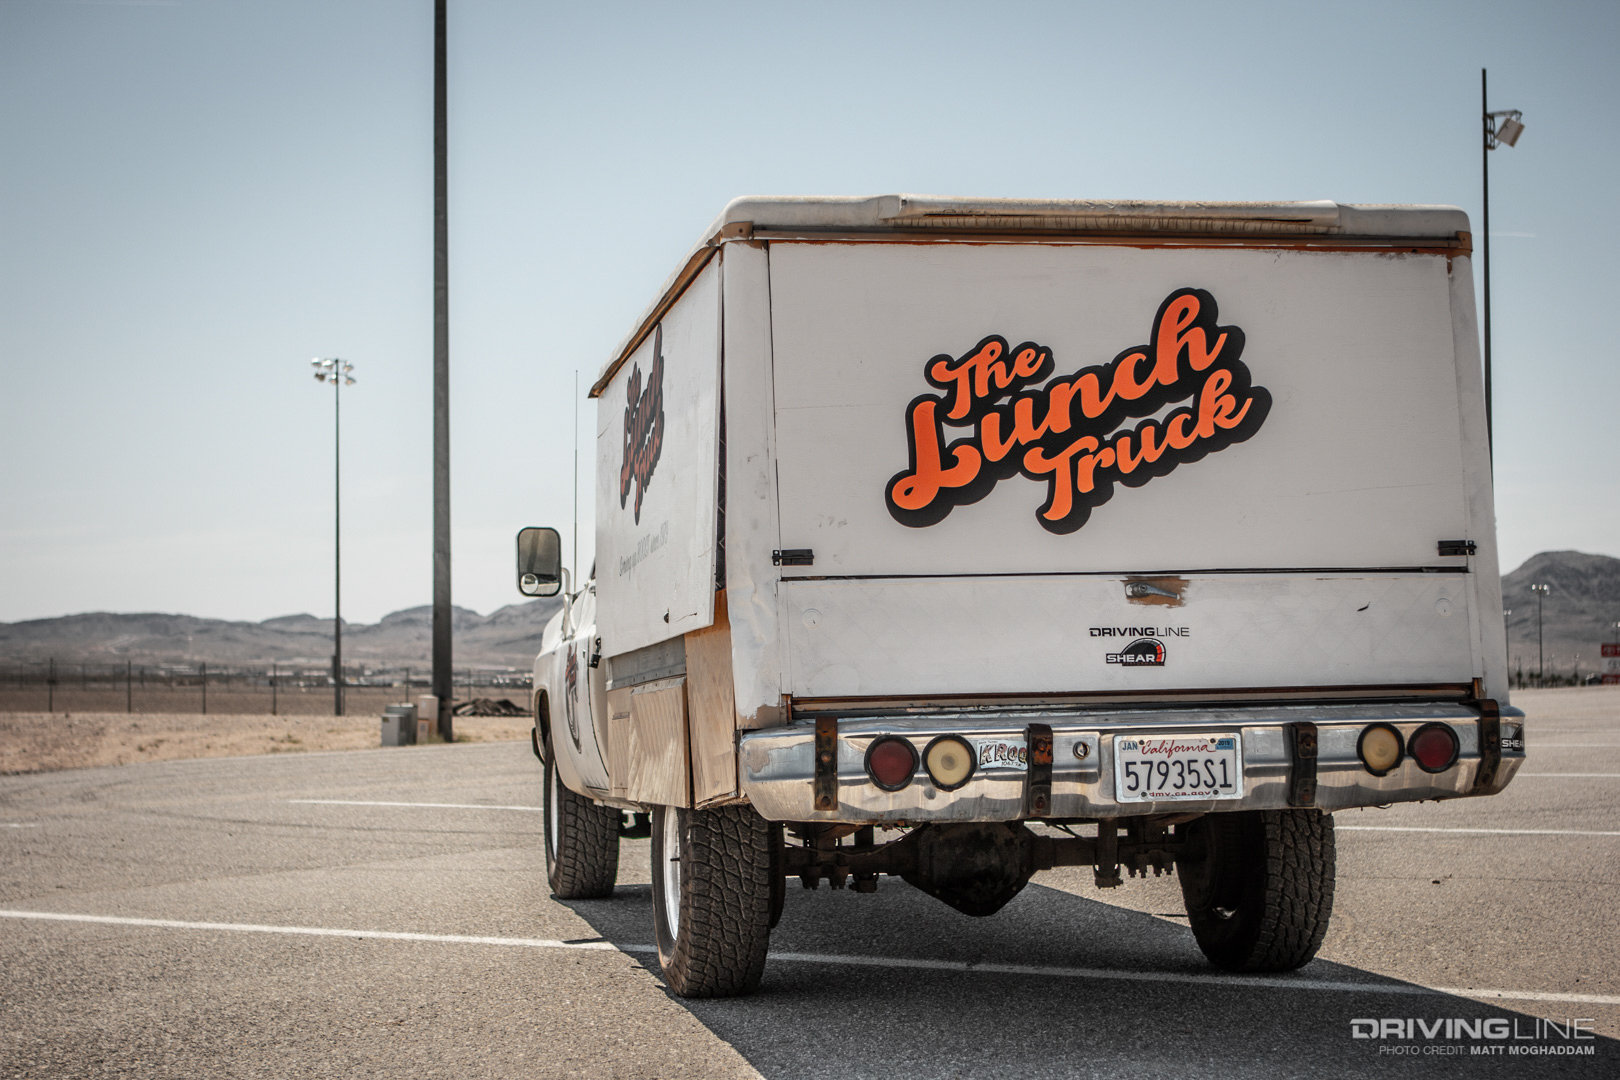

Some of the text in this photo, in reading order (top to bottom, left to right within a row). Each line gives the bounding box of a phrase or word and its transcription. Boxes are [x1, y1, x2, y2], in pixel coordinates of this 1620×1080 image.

[930, 340, 1047, 420] The
[621, 325, 664, 496] Lunch
[891, 293, 1229, 511] Lunch
[1022, 368, 1254, 522] Truck
[1089, 627, 1190, 637] DRIVINGLINE
[1106, 654, 1155, 663] SHEAR
[1122, 742, 1138, 751] JAN
[1141, 739, 1216, 758] California
[1125, 759, 1232, 791] 57935S1
